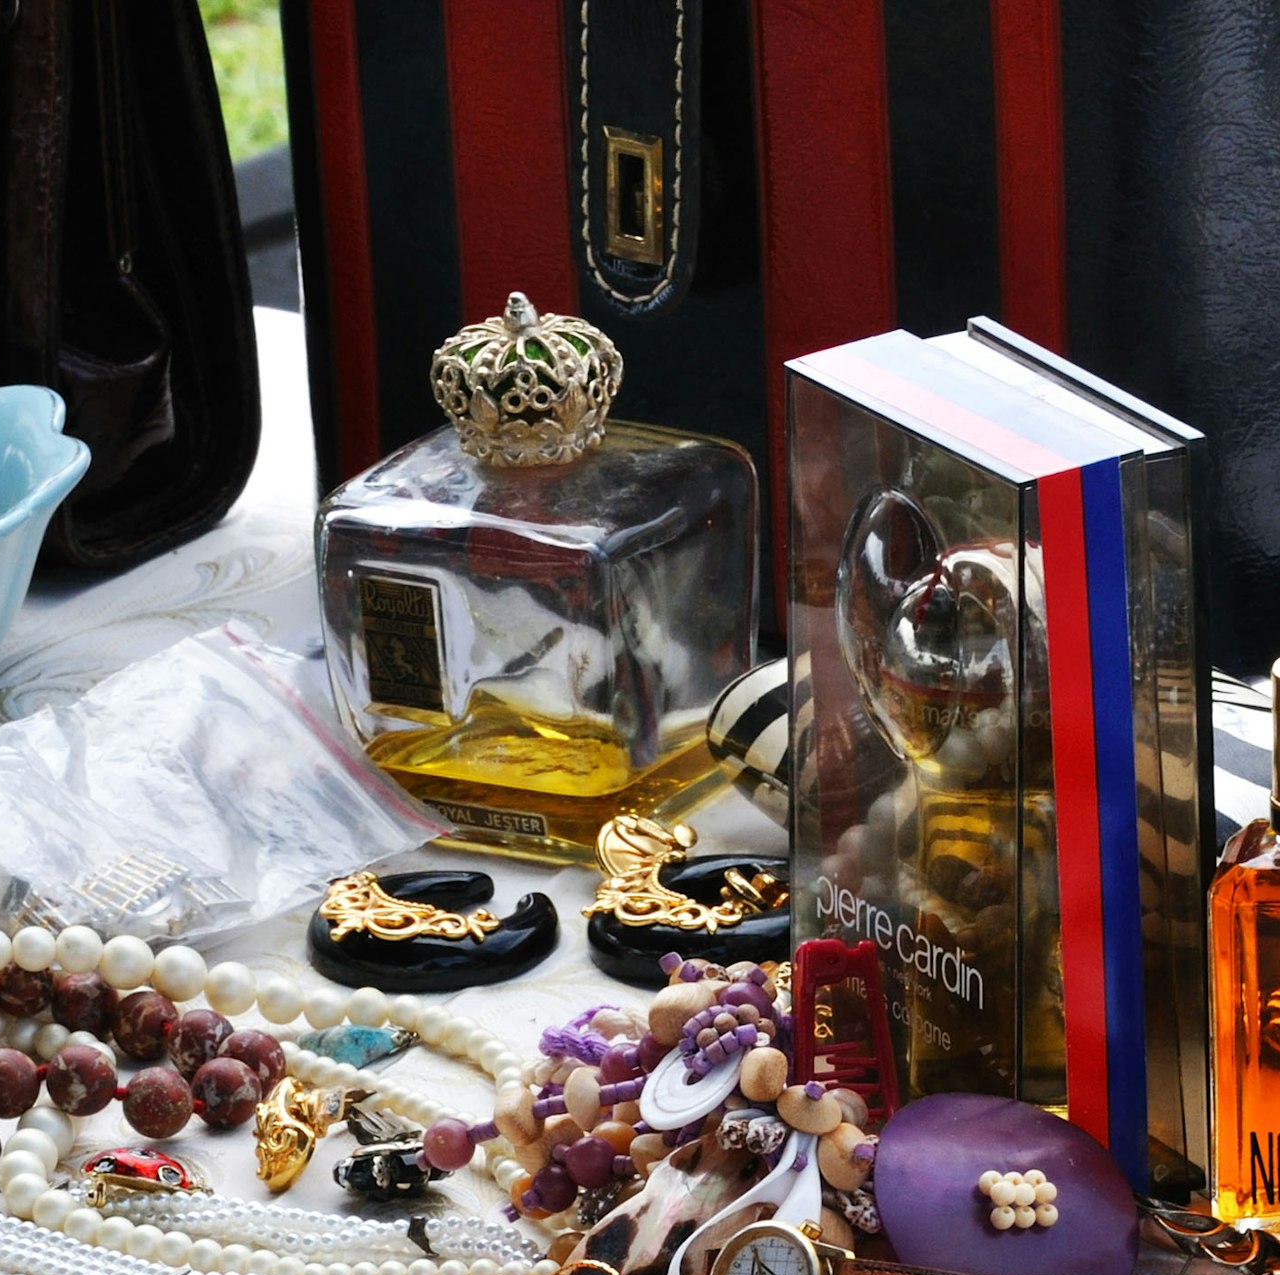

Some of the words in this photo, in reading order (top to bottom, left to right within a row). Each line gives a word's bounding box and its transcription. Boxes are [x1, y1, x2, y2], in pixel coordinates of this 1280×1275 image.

[364, 580, 432, 623] Royalty
[433, 803, 476, 824] OYAL
[484, 812, 542, 834] JESTER
[816, 872, 893, 950] pierre
[896, 924, 984, 1010] cardin
[892, 1000, 952, 1052] coogne
